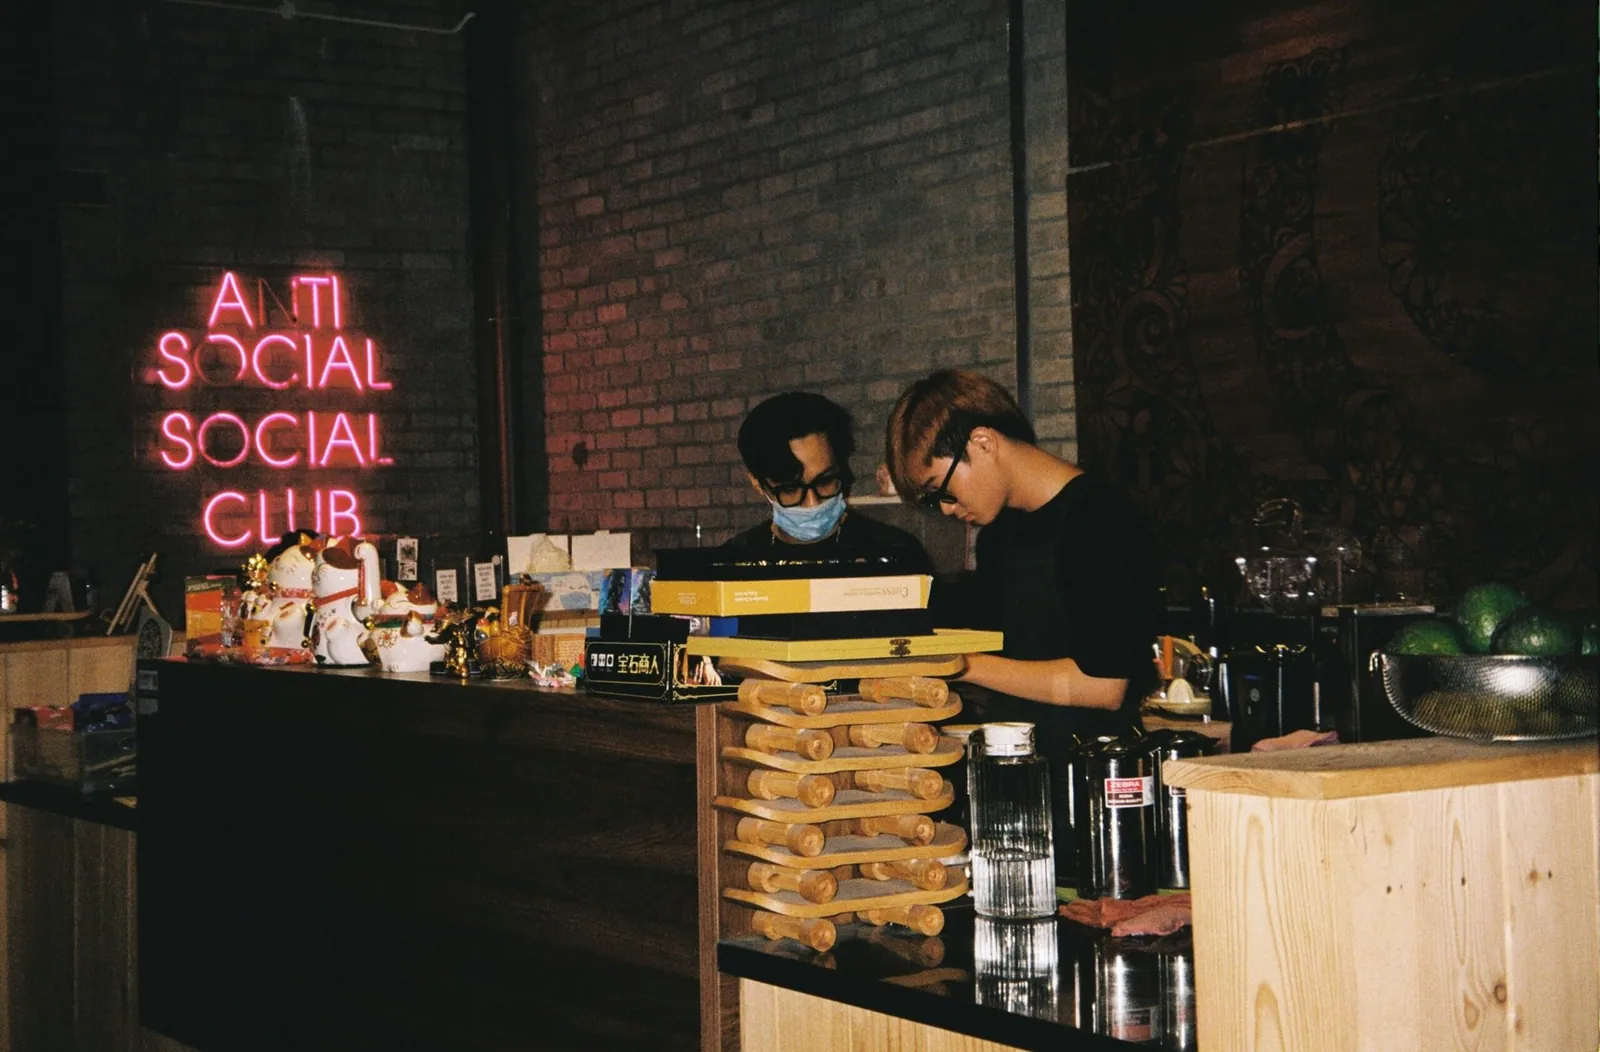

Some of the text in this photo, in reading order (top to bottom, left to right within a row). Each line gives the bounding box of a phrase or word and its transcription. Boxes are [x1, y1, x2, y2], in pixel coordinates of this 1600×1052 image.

[208, 271, 341, 329] ANTI
[157, 331, 394, 391] SOCIAL
[160, 410, 395, 470] SOCIAL
[203, 488, 361, 547] CLUB
[617, 653, 660, 675] 宝石商人
